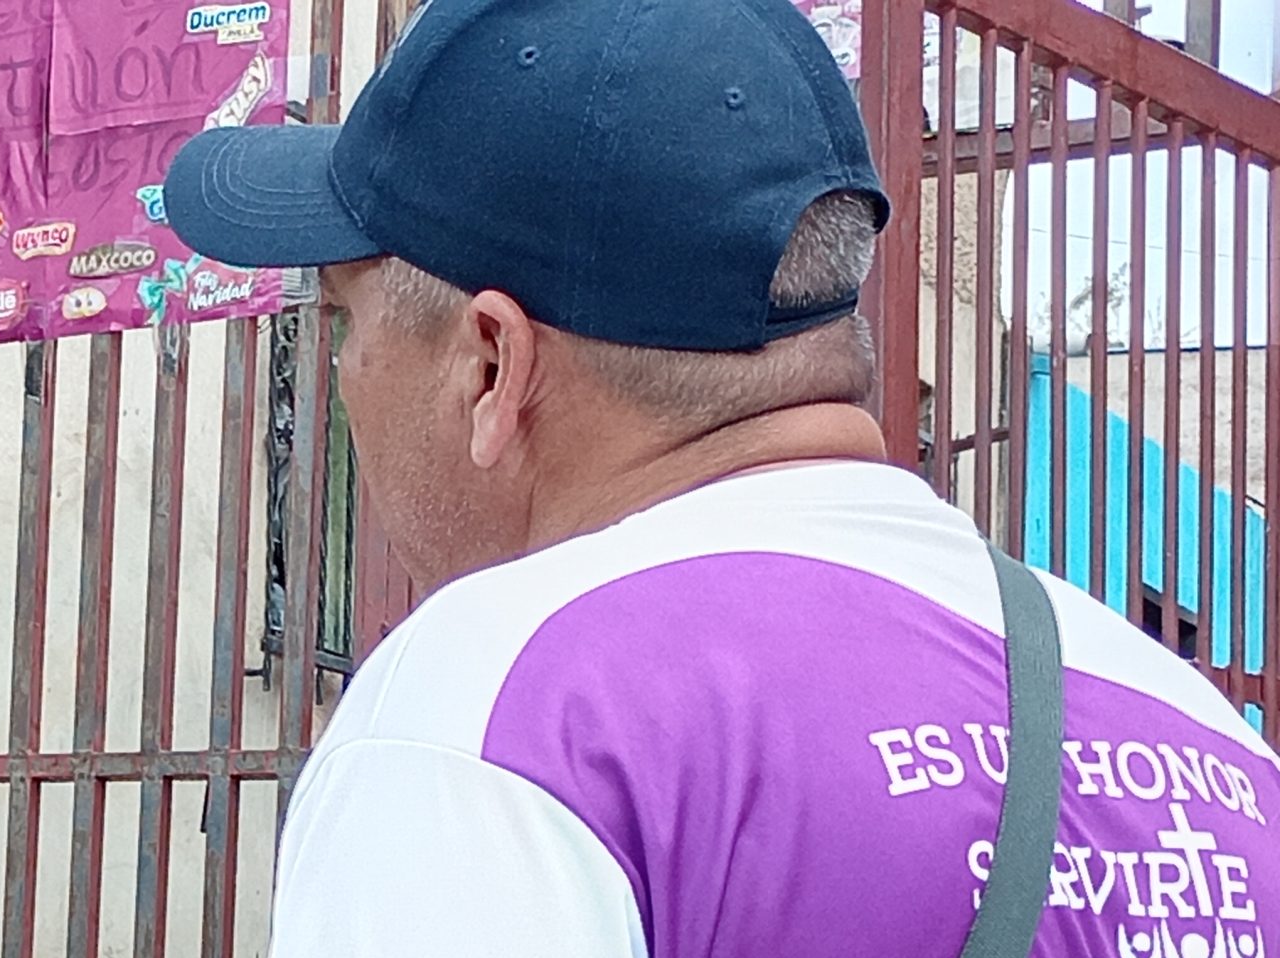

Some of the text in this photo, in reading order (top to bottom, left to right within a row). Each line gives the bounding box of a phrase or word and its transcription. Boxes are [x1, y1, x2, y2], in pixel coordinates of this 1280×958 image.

[189, 5, 267, 30] Ducrem
[70, 249, 156, 275] MAXCOCO
[188, 277, 255, 310] Navidad
[868, 723, 1267, 827] ES U HONOR
[967, 802, 1258, 922] SRVIRTE
